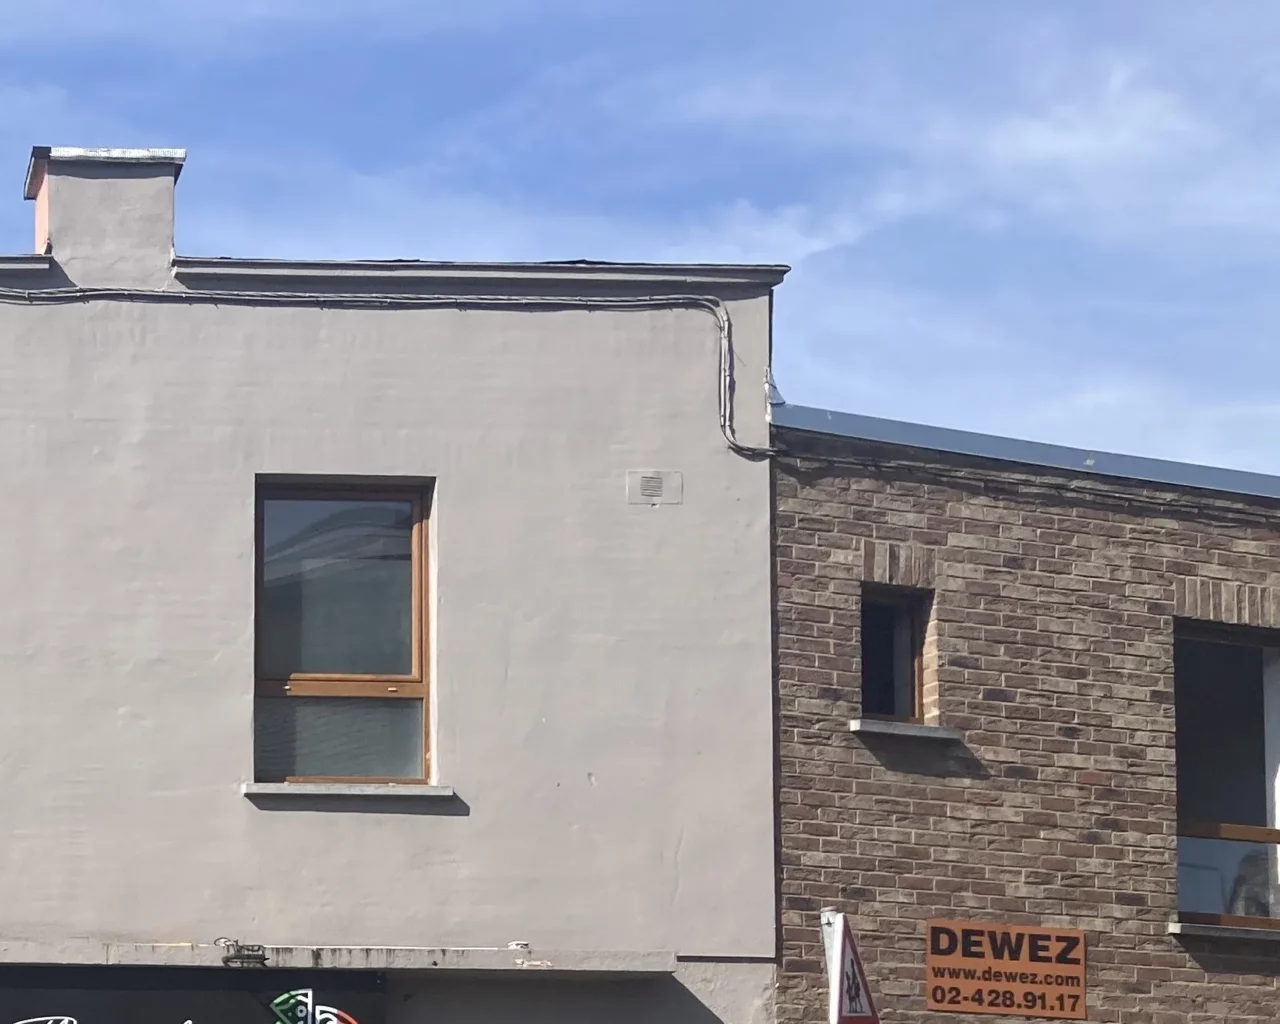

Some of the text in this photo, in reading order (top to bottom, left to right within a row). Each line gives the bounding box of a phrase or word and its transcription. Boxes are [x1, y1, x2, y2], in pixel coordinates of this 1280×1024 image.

[930, 926, 1081, 965] DEWEZ
[931, 966, 1081, 988] www.dewez.com
[931, 986, 1080, 1013] 02-428.91.17
